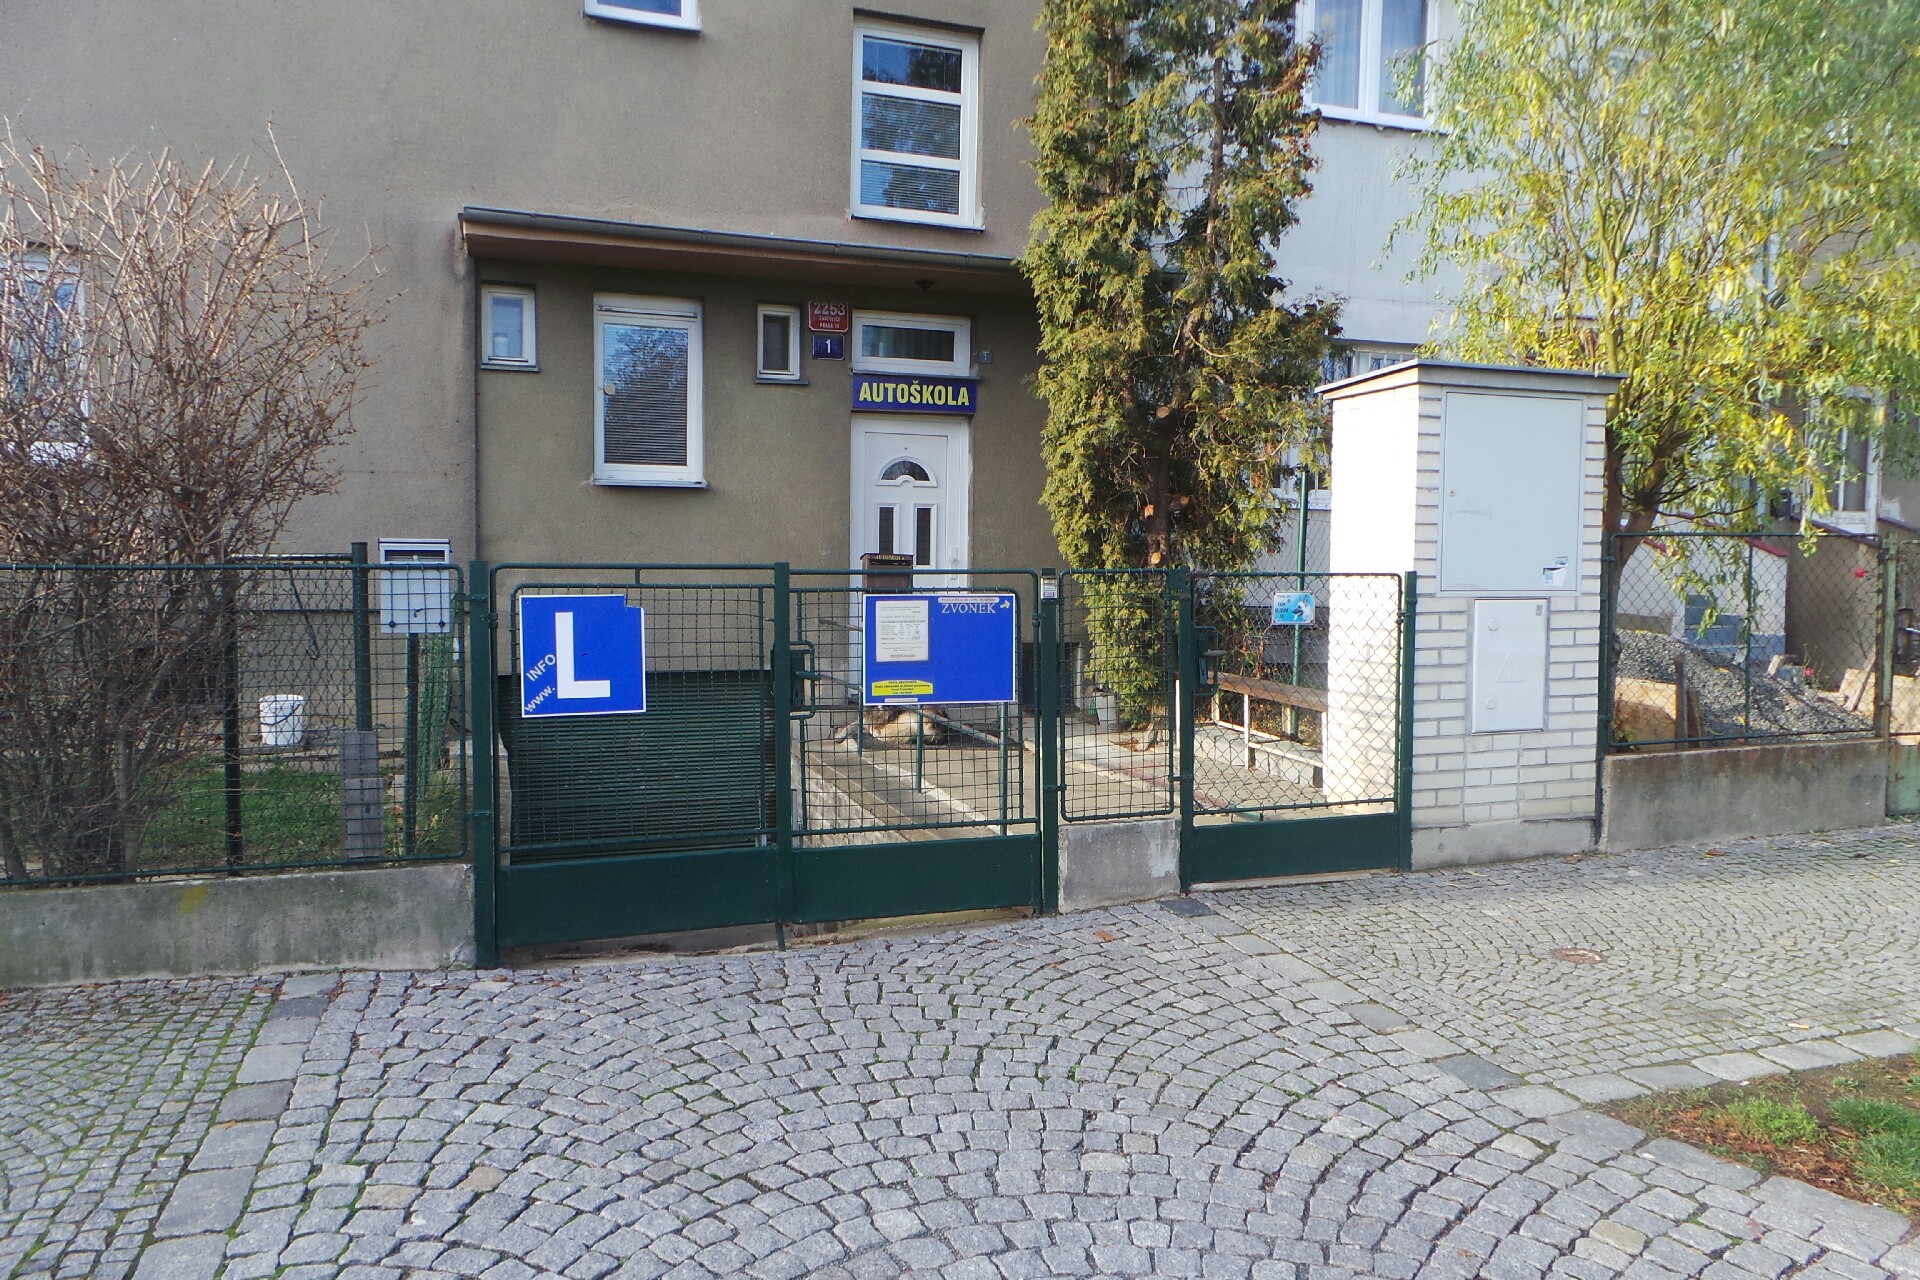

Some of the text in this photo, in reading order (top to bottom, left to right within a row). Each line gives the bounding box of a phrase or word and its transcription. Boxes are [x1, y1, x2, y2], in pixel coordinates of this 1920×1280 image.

[814, 302, 846, 316] 2253
[825, 338, 831, 354] 1
[859, 379, 970, 406] AUTOŠKOLA
[941, 603, 996, 614] ZVONEK
[555, 611, 611, 699] L
[526, 654, 556, 682] INFO
